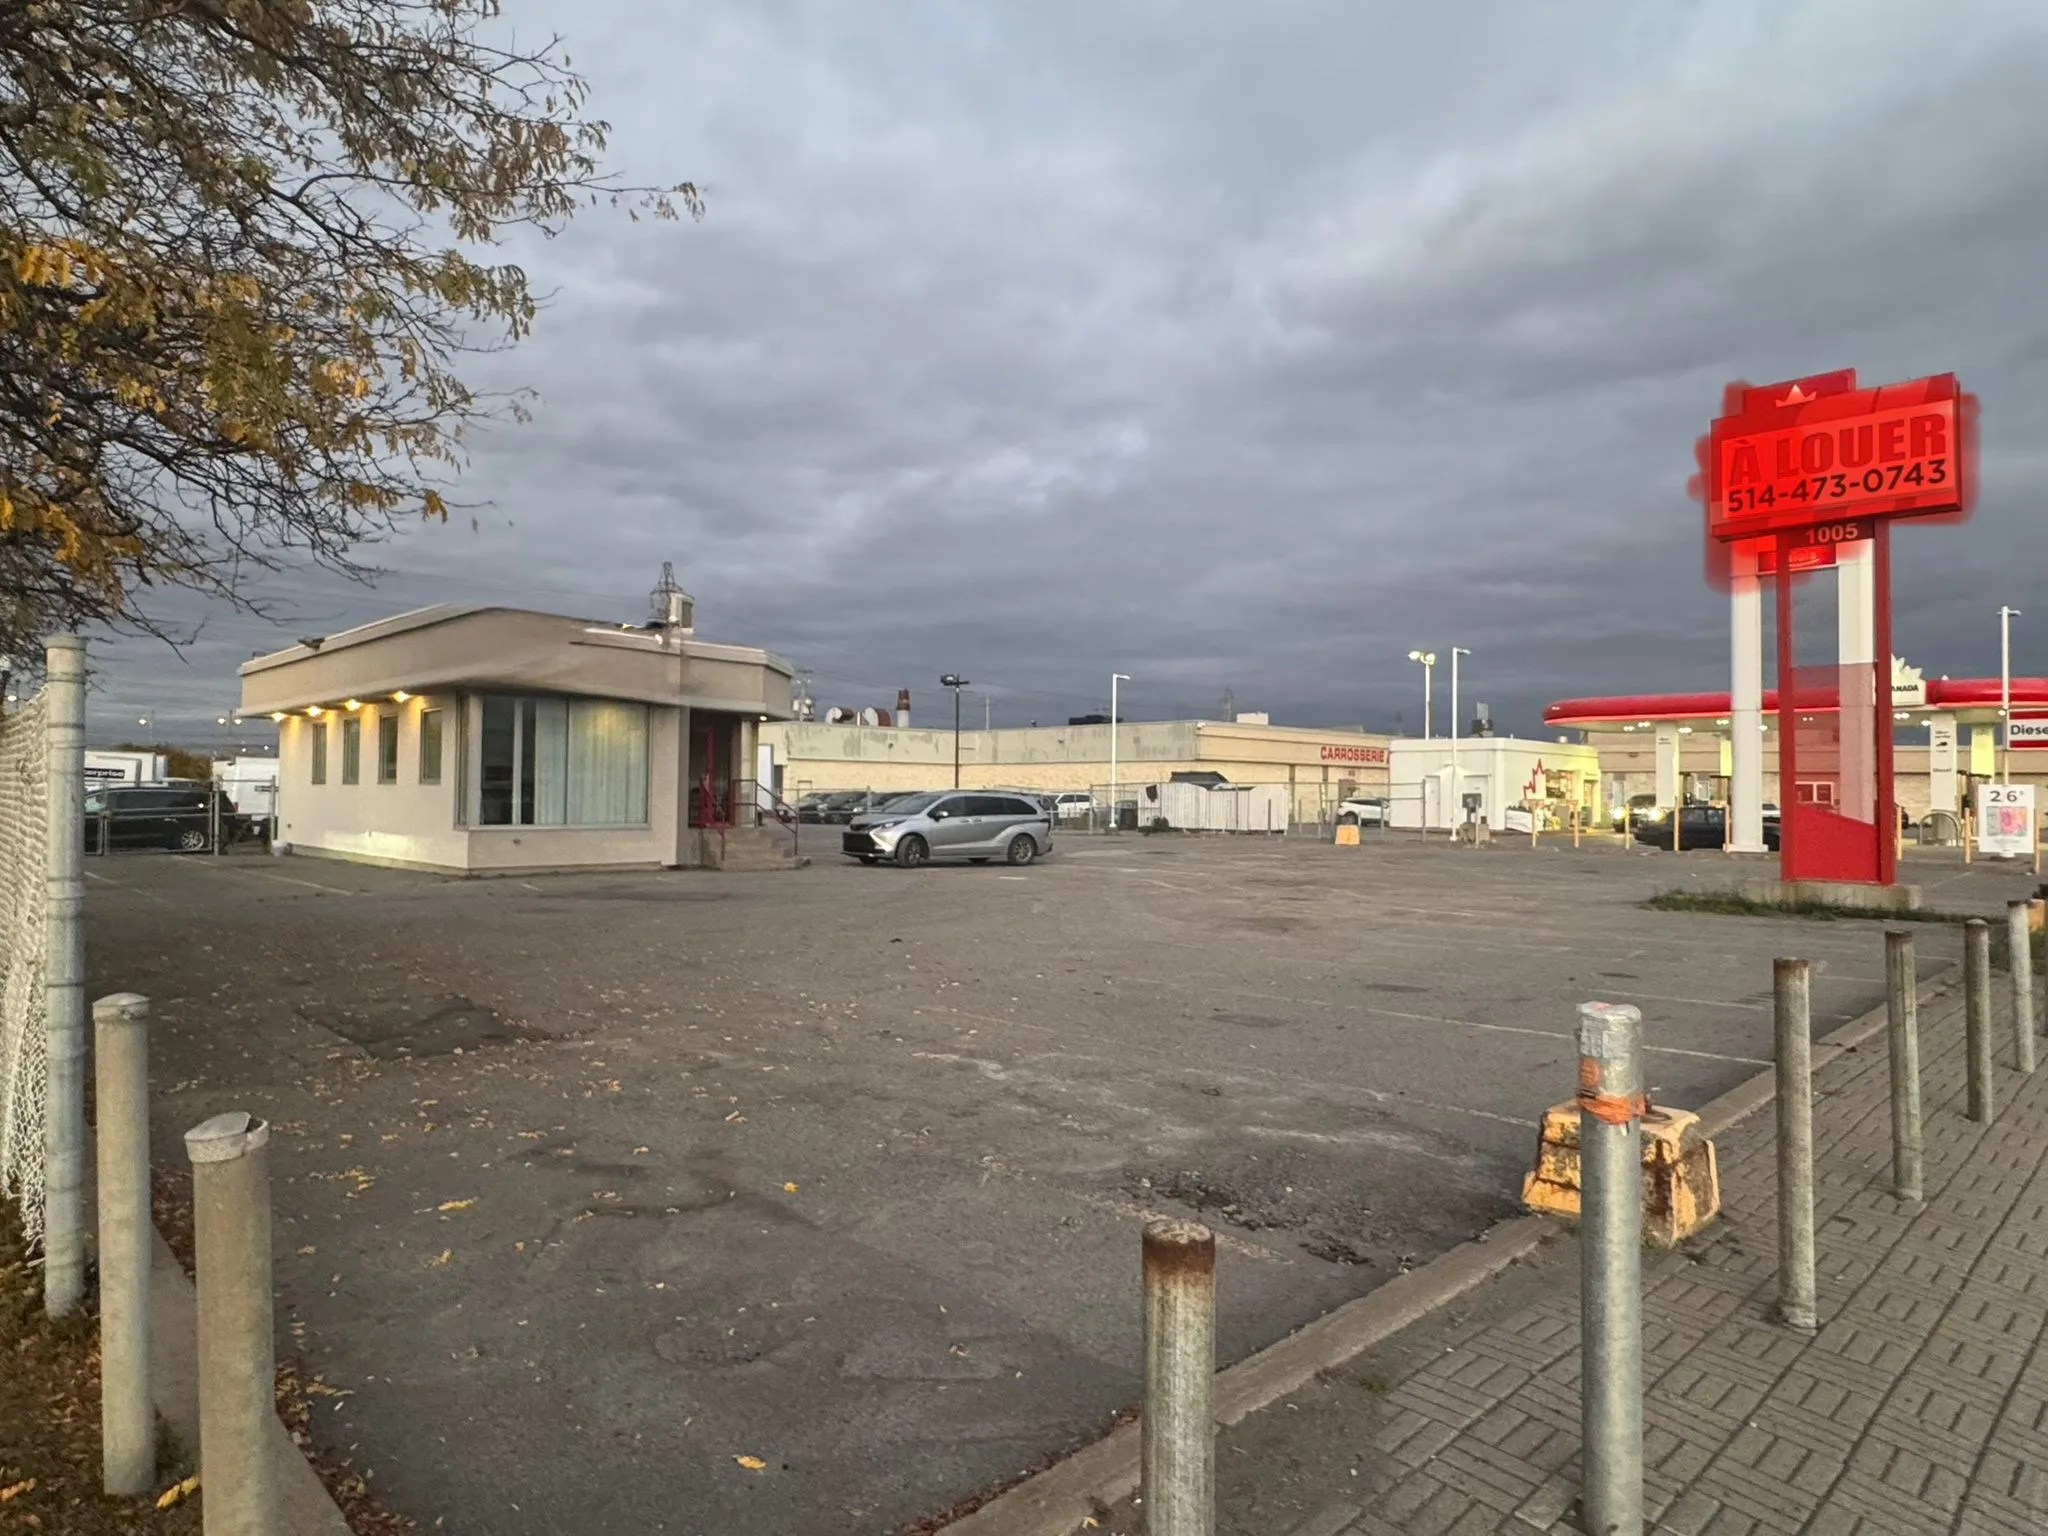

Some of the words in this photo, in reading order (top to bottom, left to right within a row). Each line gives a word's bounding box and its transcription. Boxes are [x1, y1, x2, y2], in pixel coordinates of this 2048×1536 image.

[1776, 413, 1946, 480] LOUER
[1728, 458, 1946, 513] 514-473-0743
[1806, 523, 1858, 544] 1005
[1891, 684, 1919, 692] ANADA
[2010, 724, 2048, 735] Diese
[1320, 746, 1385, 762] CARROSSERIE
